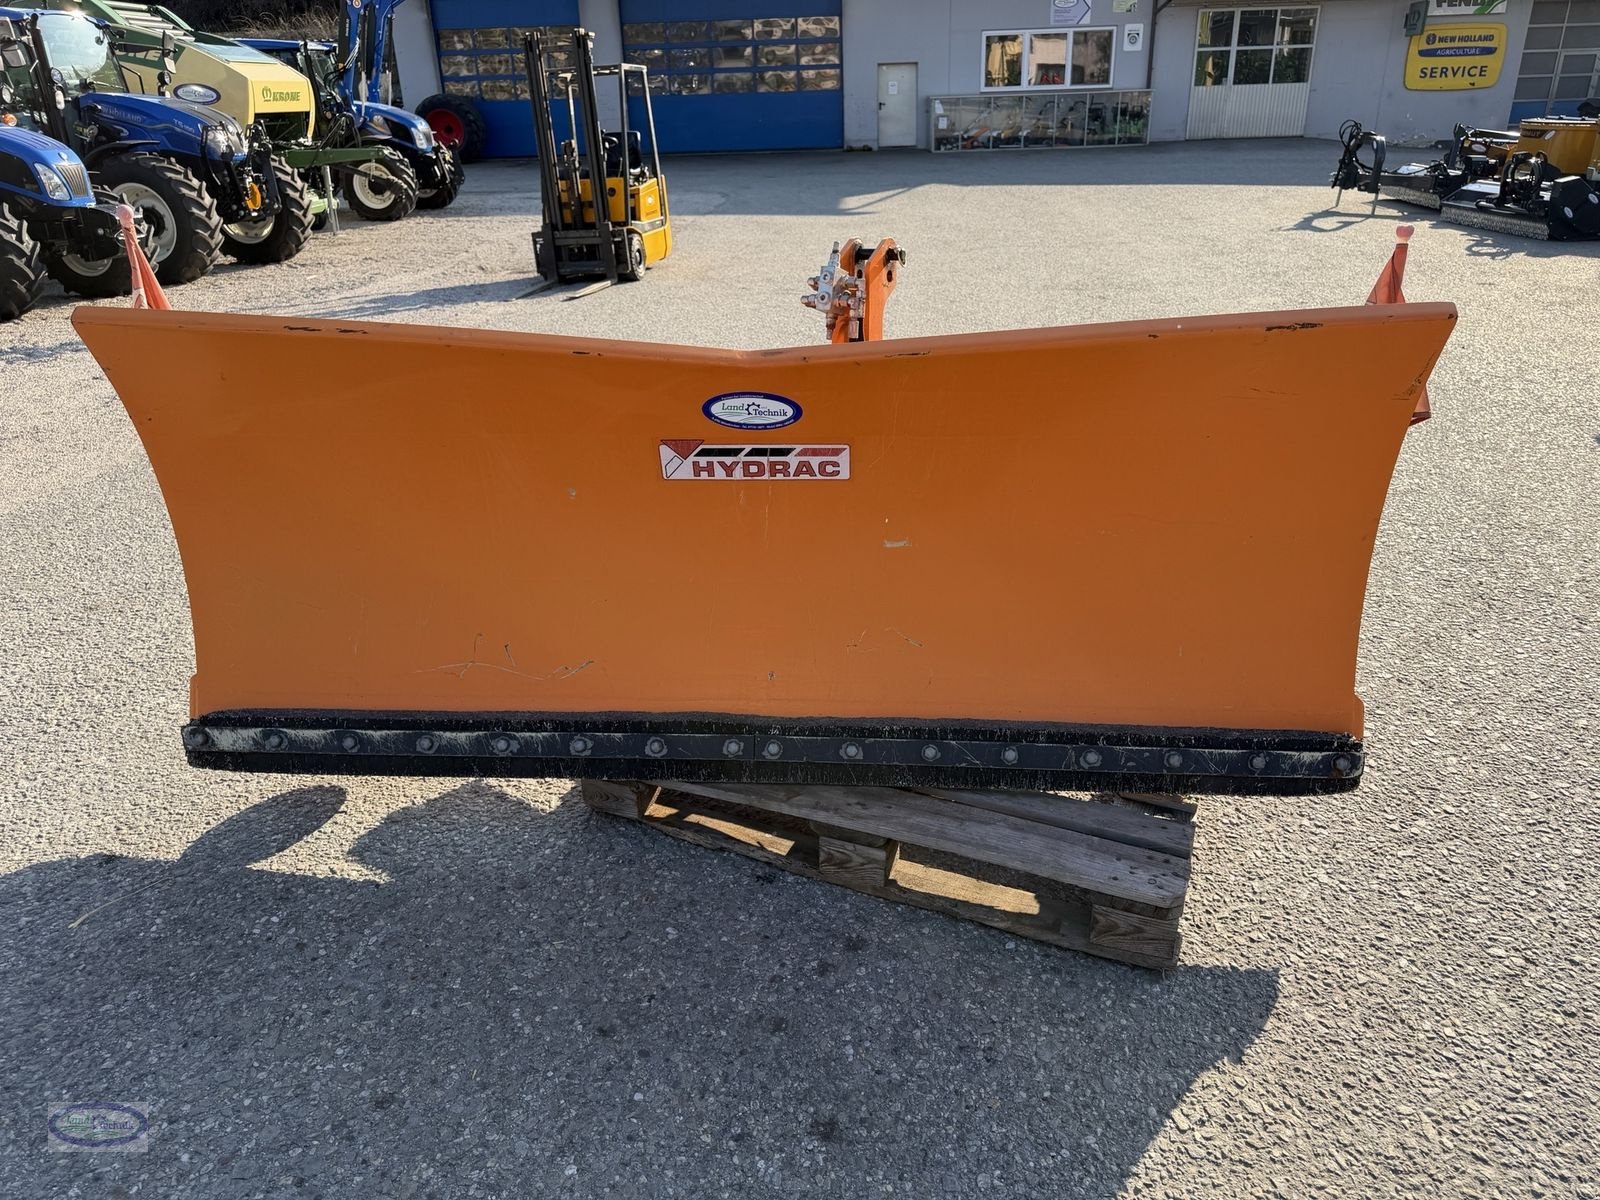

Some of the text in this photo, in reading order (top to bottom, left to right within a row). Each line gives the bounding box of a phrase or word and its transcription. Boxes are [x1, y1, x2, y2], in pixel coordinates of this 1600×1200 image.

[1438, 34, 1494, 43] NEW HOLLAND
[1436, 47, 1480, 55] AGRICULTURE
[1419, 65, 1489, 79] SERVICE
[272, 91, 300, 102] KRONE
[722, 402, 744, 411] Land
[753, 408, 788, 417] Technik
[692, 460, 840, 478] HYDRAC
